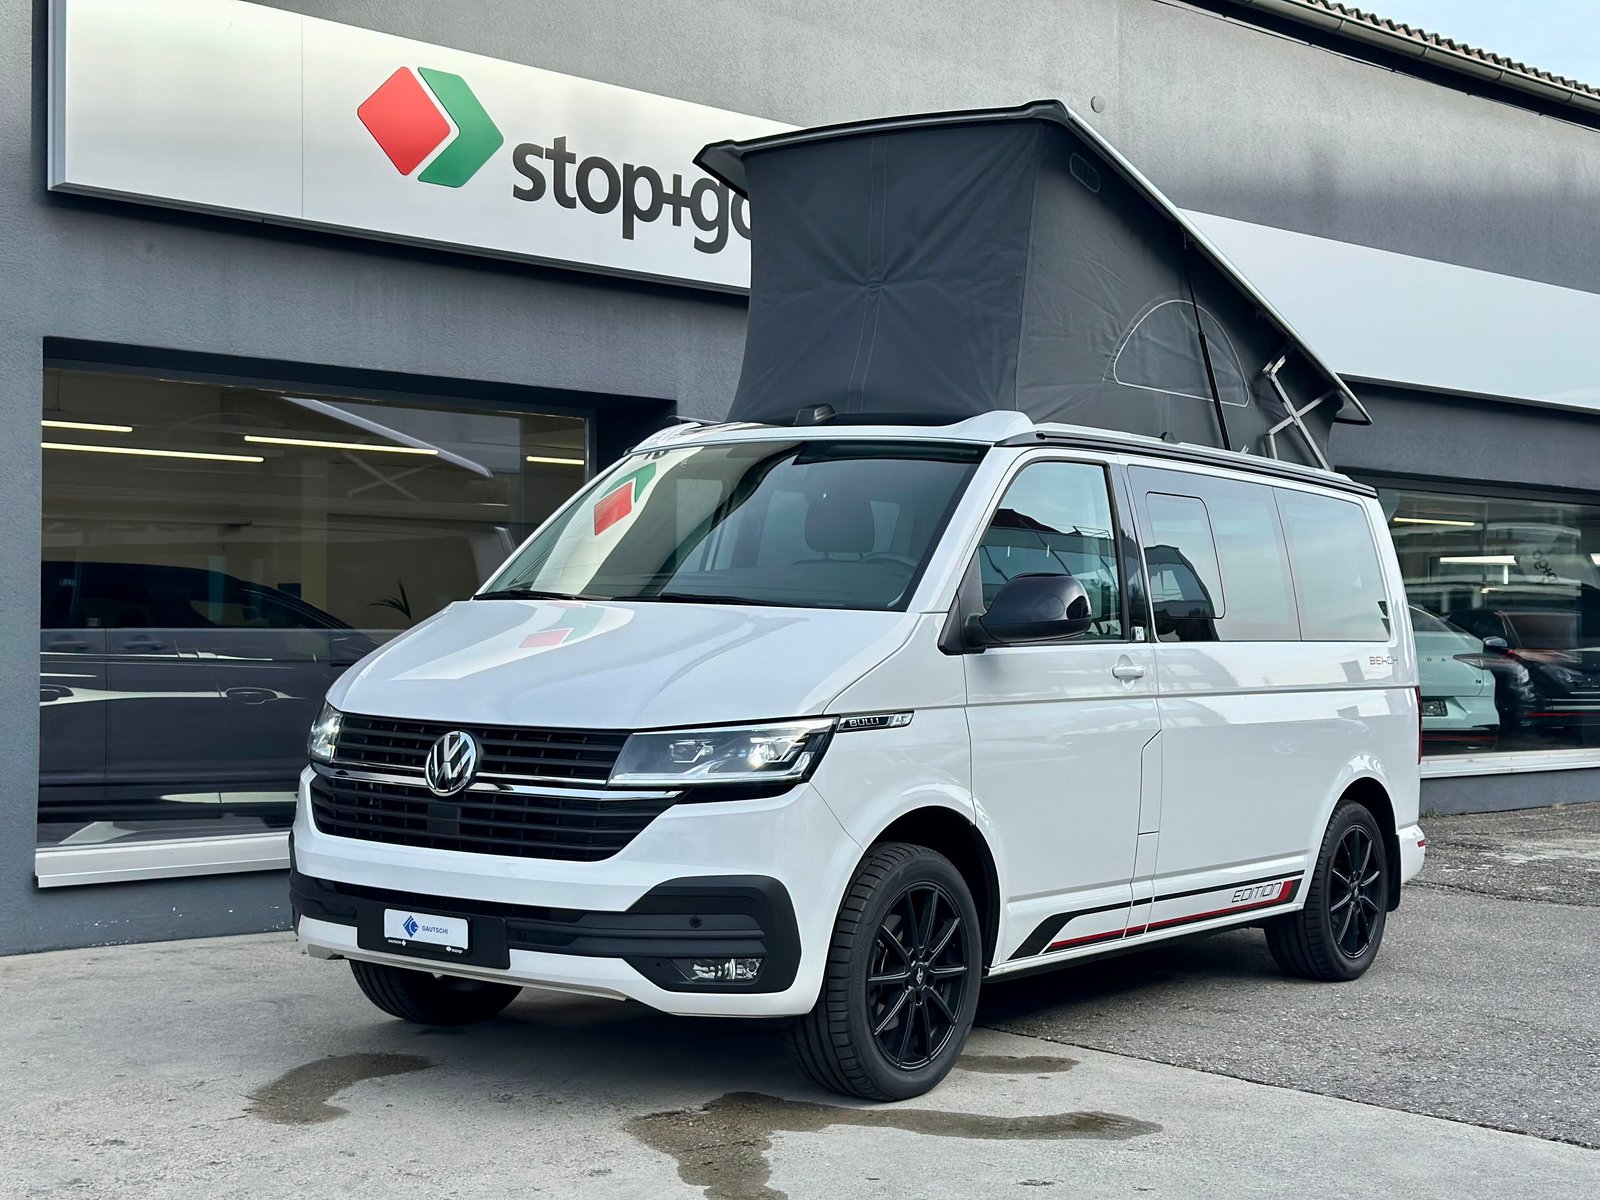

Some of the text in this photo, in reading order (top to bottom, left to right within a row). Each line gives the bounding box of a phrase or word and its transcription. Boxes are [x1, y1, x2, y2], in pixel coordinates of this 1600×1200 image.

[849, 718, 879, 727] BULLI
[1231, 882, 1283, 903] EDITION
[422, 926, 448, 934] GAUTSCHI
